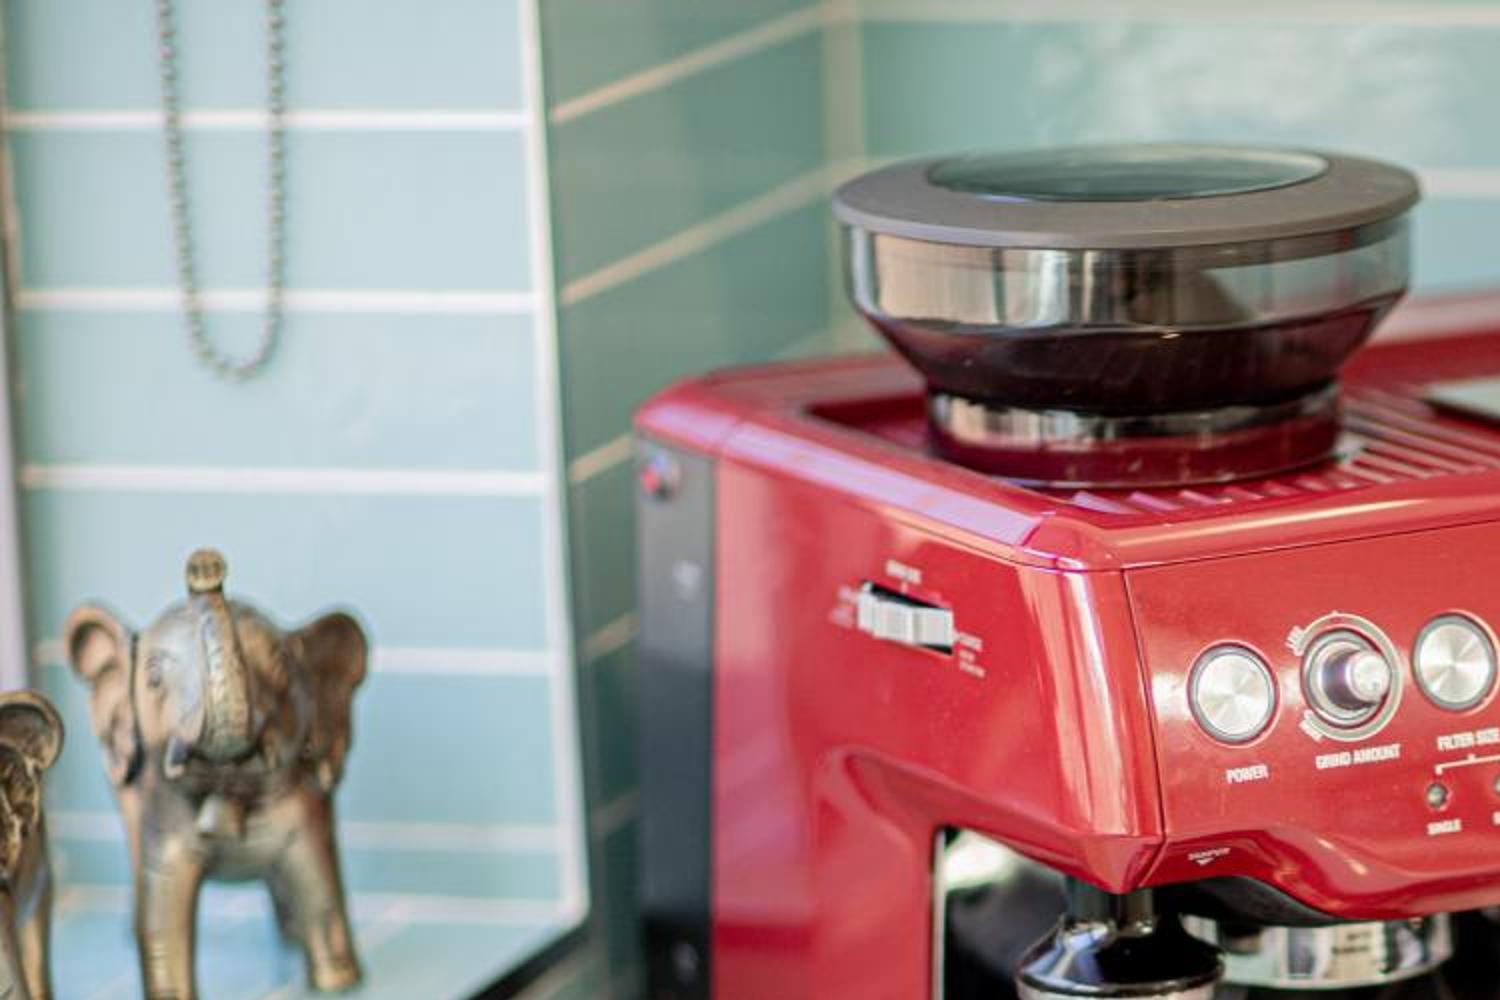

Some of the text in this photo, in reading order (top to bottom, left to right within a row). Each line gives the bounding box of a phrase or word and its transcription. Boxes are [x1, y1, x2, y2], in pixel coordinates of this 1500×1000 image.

[1437, 731, 1474, 751] FILTER
[1315, 751, 1351, 770] GRIND
[1226, 763, 1269, 784] POWER
